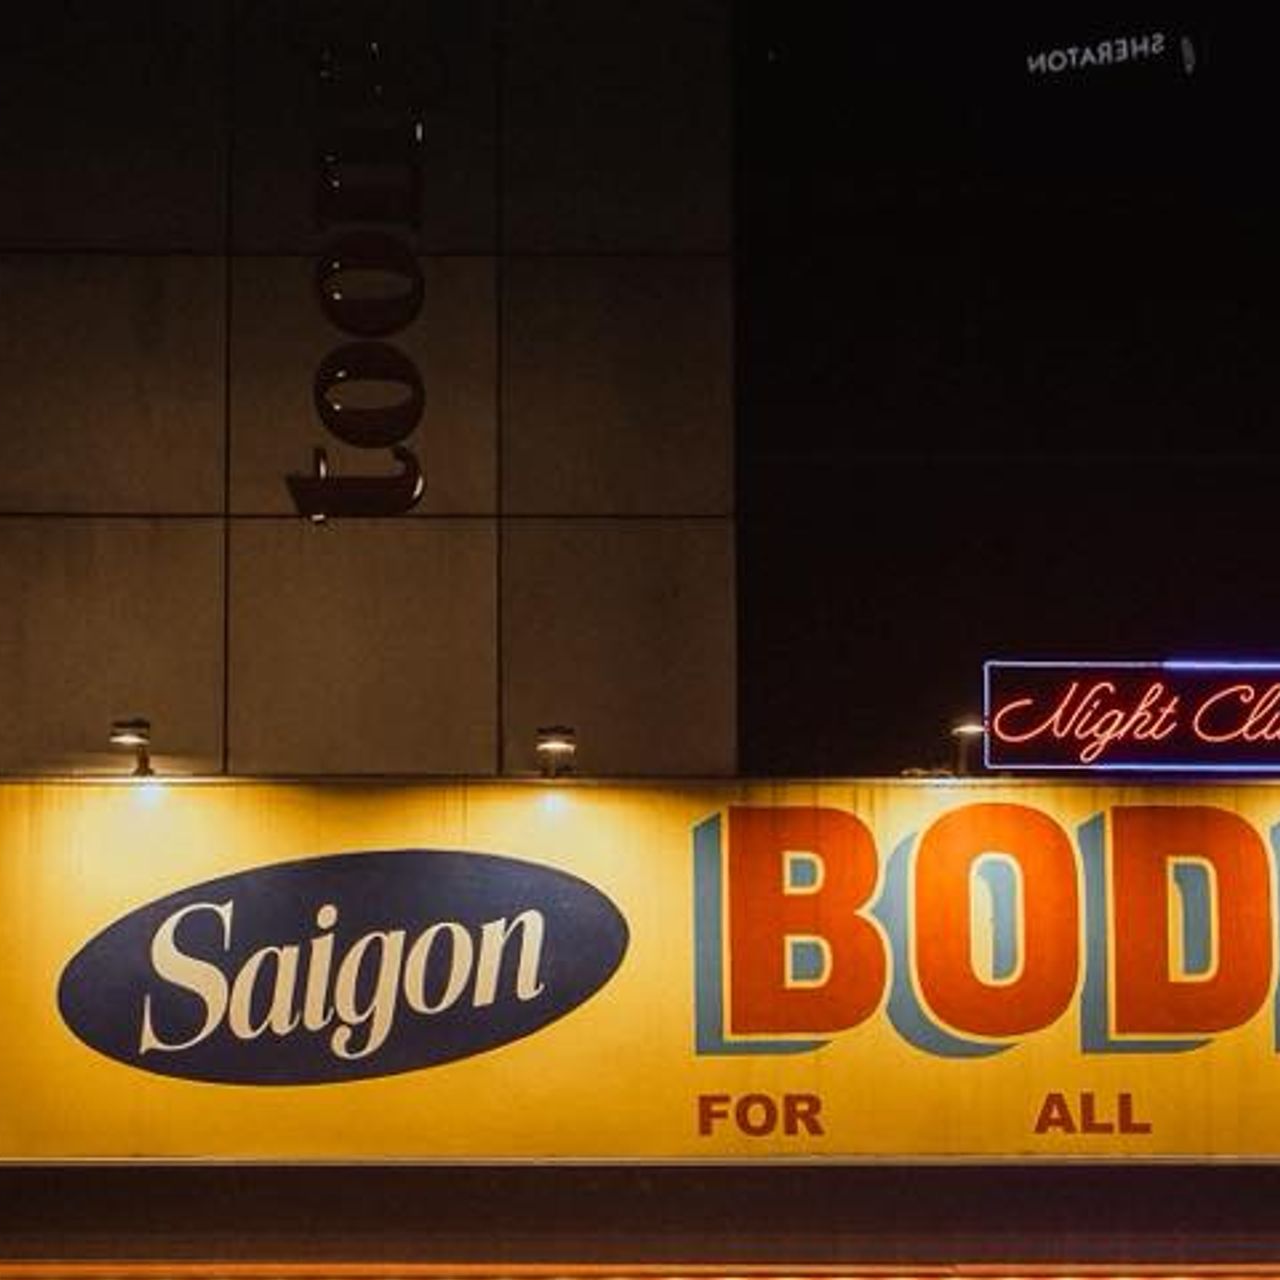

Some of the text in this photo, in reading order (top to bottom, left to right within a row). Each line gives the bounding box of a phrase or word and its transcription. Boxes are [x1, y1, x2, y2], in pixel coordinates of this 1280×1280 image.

[993, 681, 1179, 762] Night
[140, 898, 546, 1060] Saigon
[698, 1093, 825, 1136] FOR
[1033, 1092, 1153, 1134] ALL
